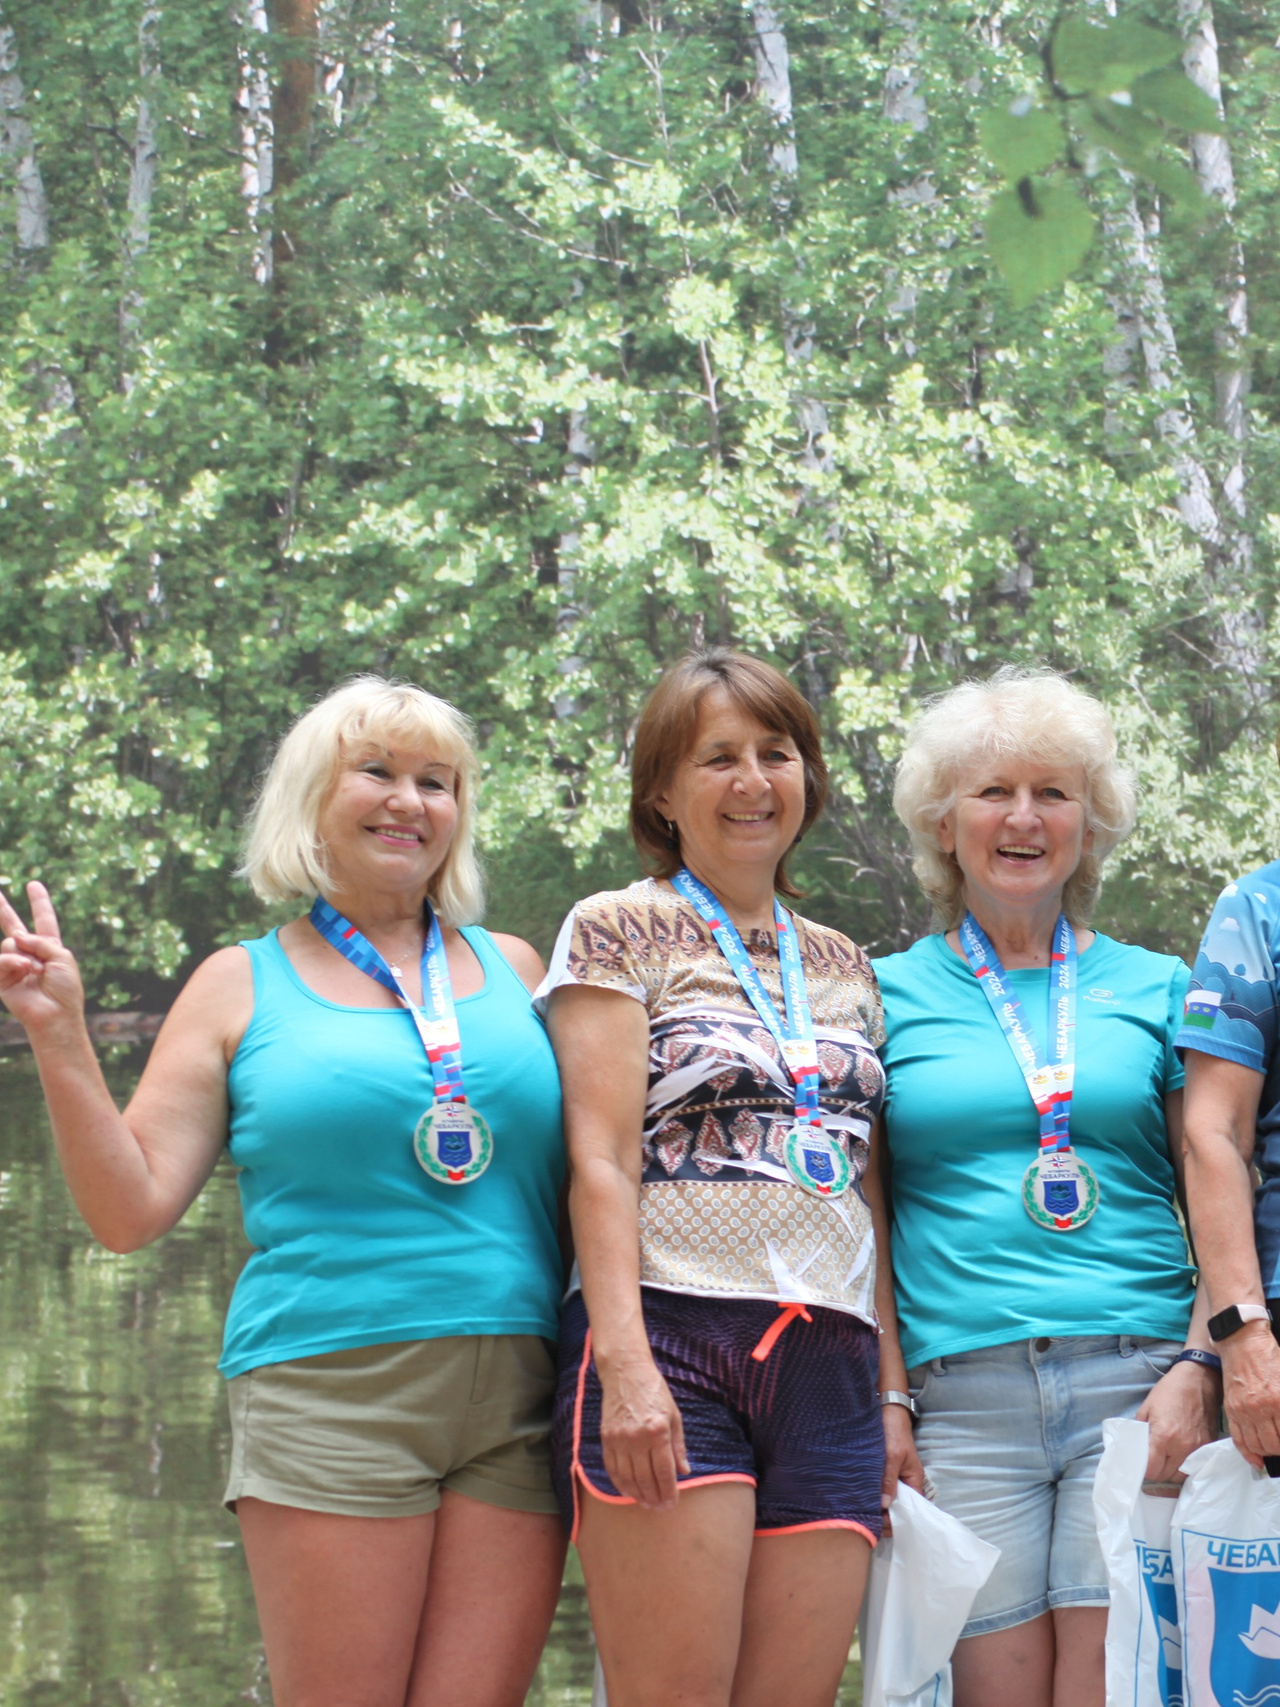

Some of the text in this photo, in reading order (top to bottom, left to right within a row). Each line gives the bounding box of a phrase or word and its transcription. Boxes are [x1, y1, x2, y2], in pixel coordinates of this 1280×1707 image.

[718, 925, 782, 1034] ЧЕБАРКУЛЬ 2024
[783, 935, 796, 963] 2024
[787, 970, 806, 1035] ЧЕБАРКУЛЬ
[986, 970, 1037, 1066] ЧЕБАРКУЛЬ 2024
[1055, 964, 1071, 1059] ЧЕБАРКУЛЬ 2024
